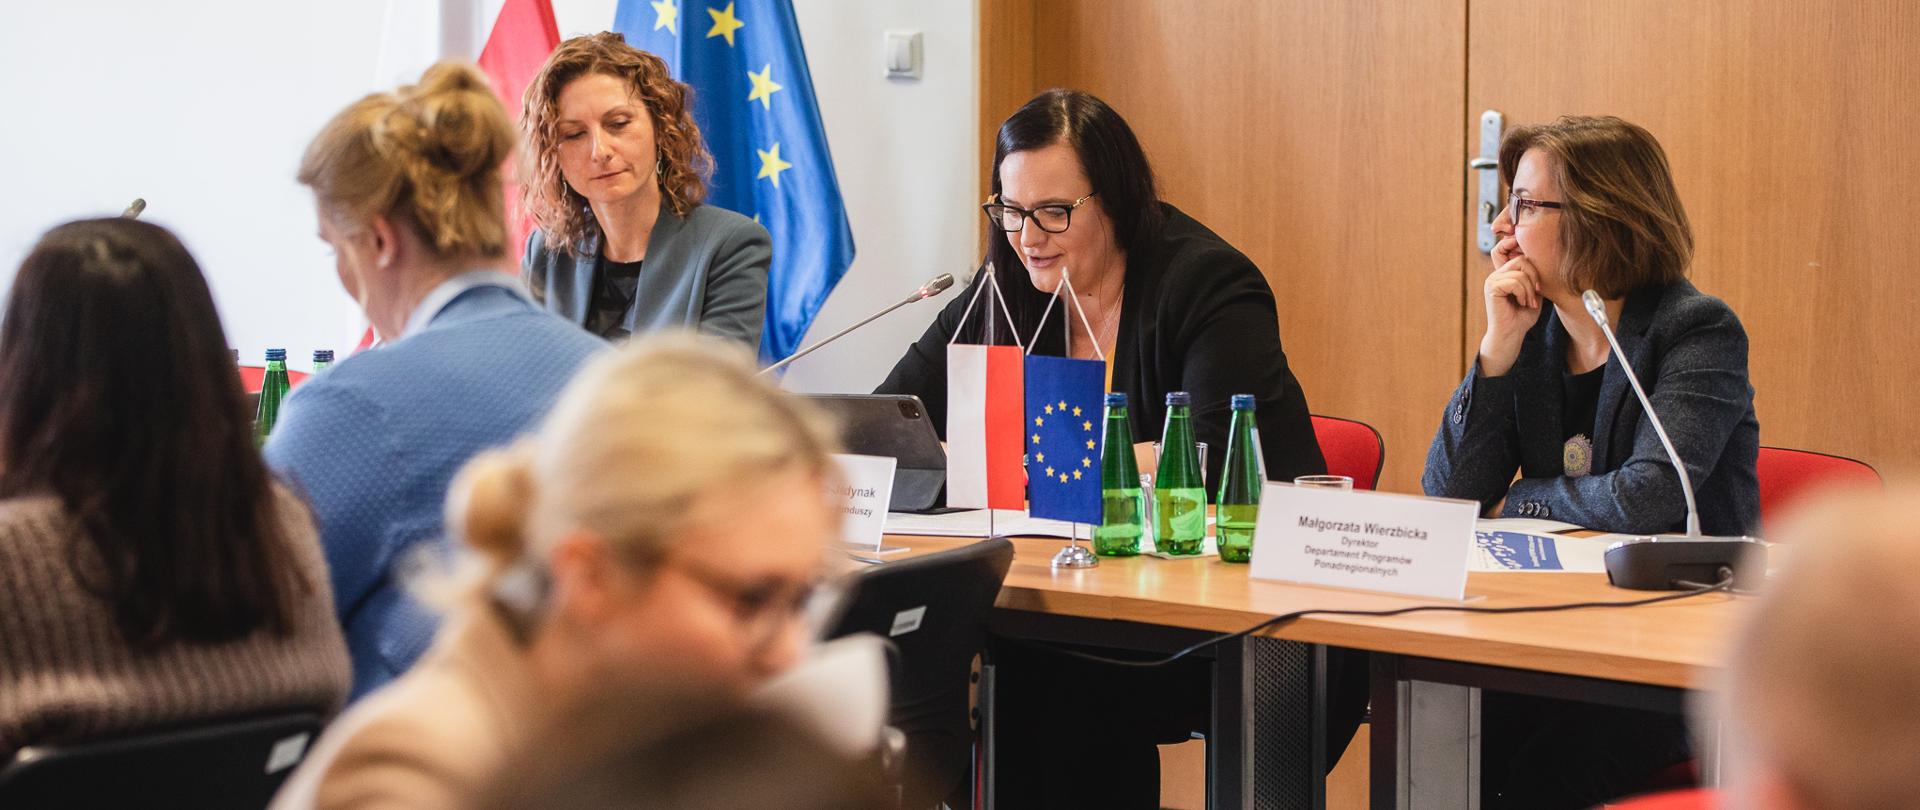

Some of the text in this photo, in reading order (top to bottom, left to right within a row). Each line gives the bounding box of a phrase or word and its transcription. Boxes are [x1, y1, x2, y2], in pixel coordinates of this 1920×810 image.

[1298, 516, 1428, 540] Małgorzata Wierzbicka
[1341, 536, 1379, 548] Dyrektor
[1304, 545, 1412, 565] Departament Programów
[1314, 559, 1398, 577] Ponadregionalnych
